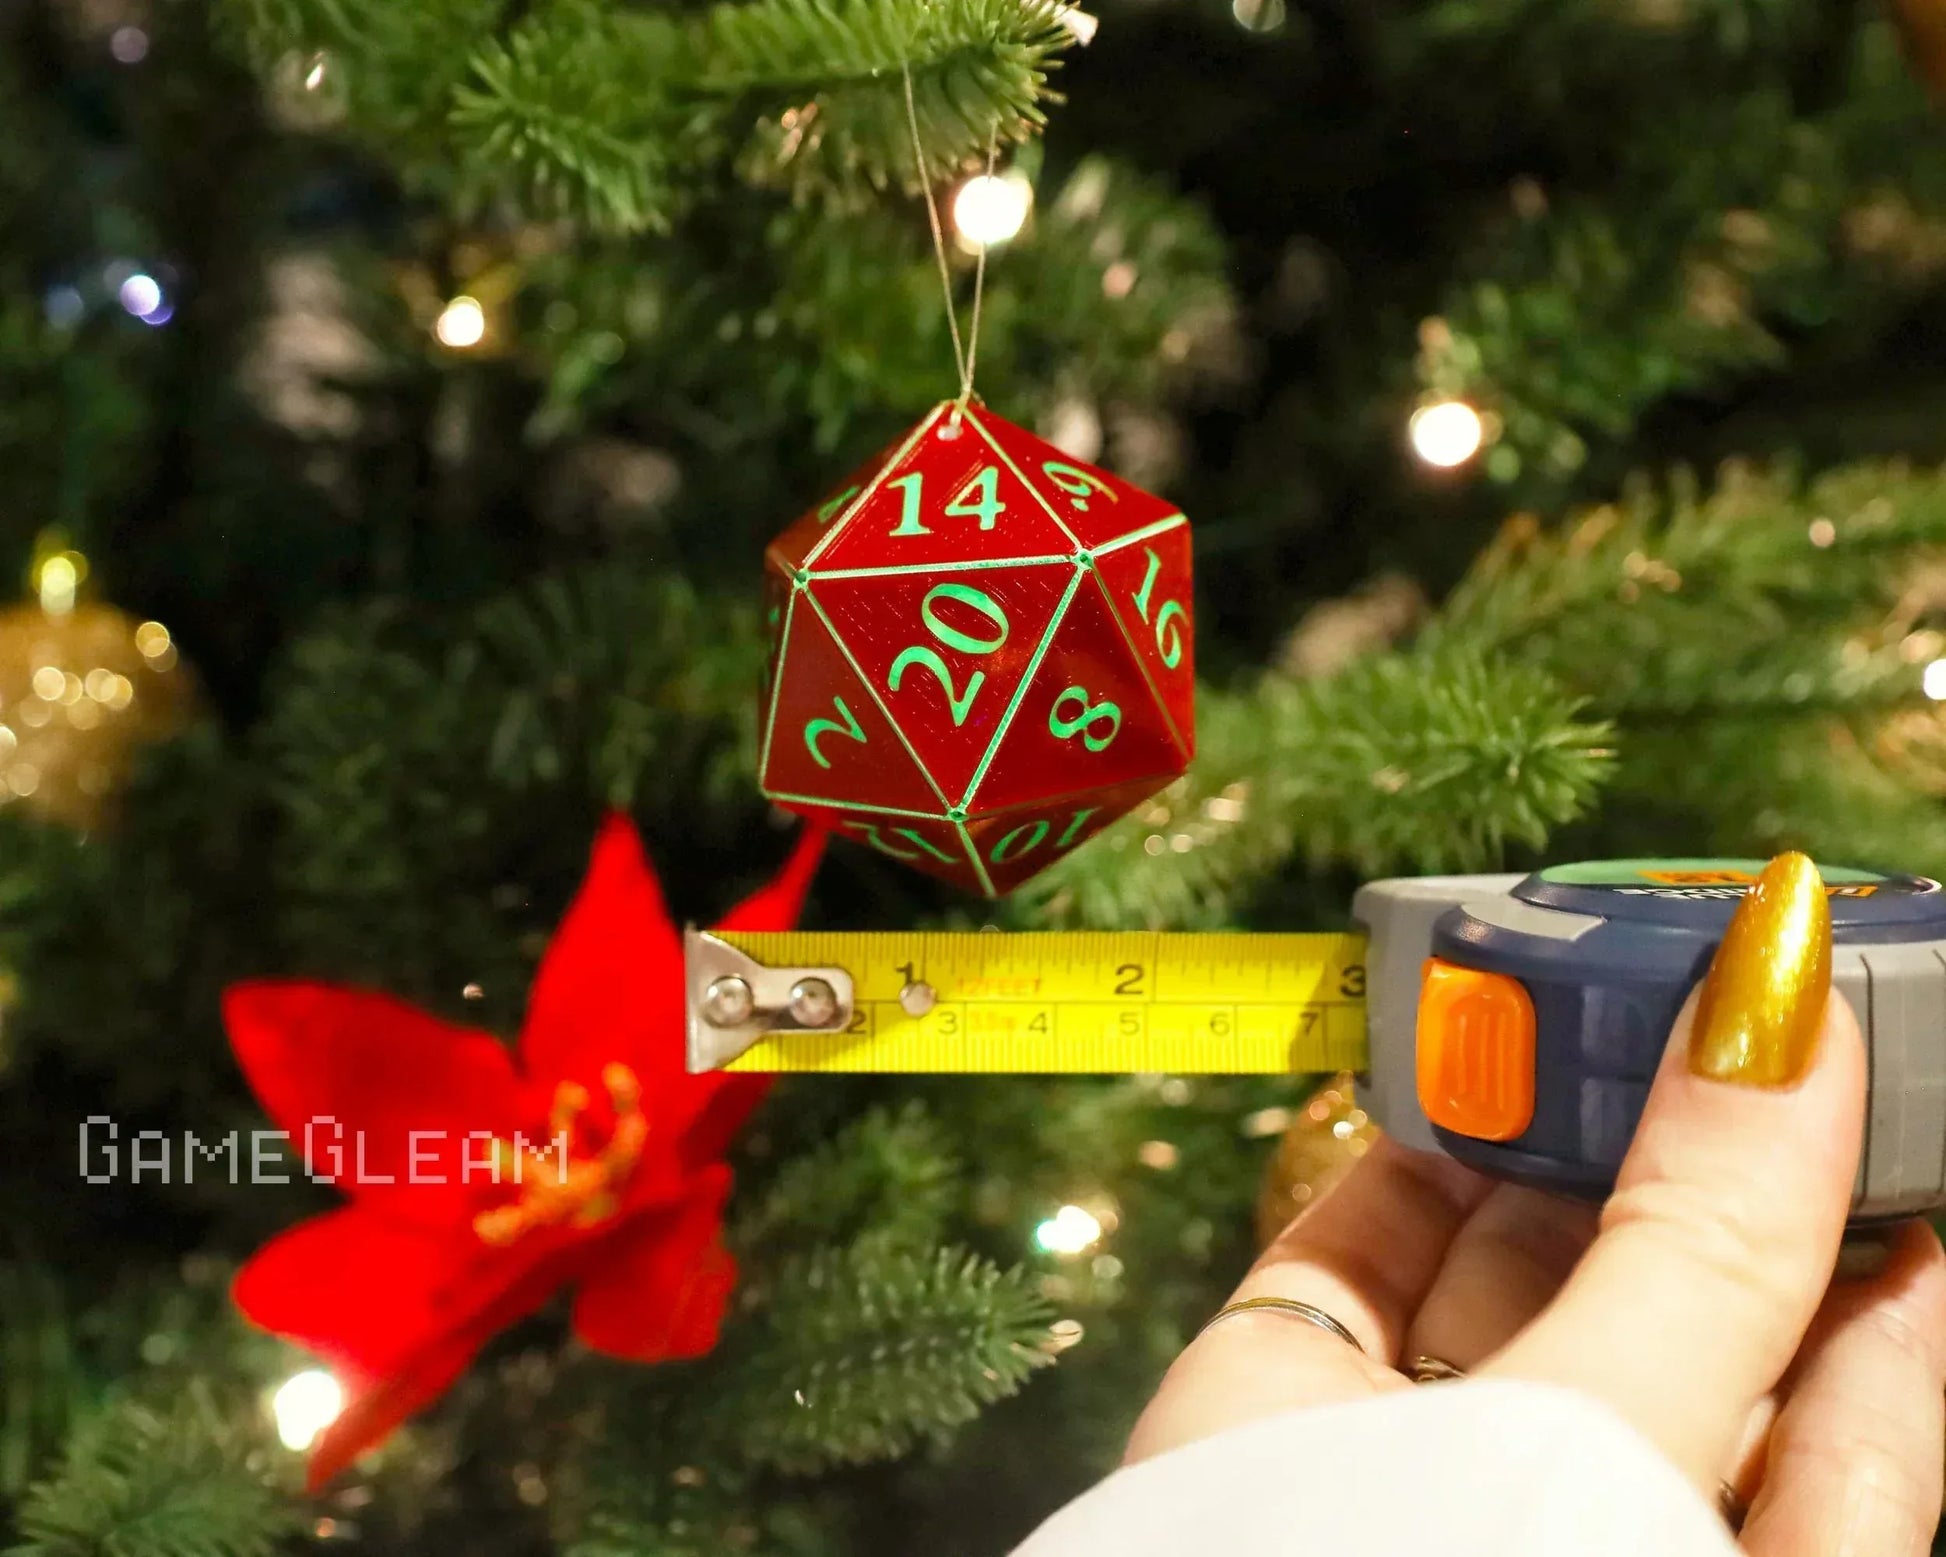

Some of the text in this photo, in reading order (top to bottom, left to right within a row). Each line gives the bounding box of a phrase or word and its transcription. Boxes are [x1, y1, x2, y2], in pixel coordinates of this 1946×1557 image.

[887, 466, 1006, 537] 14
[1131, 546, 1189, 669] 16
[888, 583, 1009, 727] 20
[805, 696, 867, 768] 2
[1049, 686, 1121, 752] 8
[1114, 963, 1144, 996] 2
[1340, 964, 1366, 998] 3
[938, 1010, 959, 1035] 3
[1028, 1010, 1048, 1035] 4
[1119, 1011, 1140, 1036] 5
[1210, 1011, 1231, 1037] 6
[1299, 1011, 1319, 1036] 7
